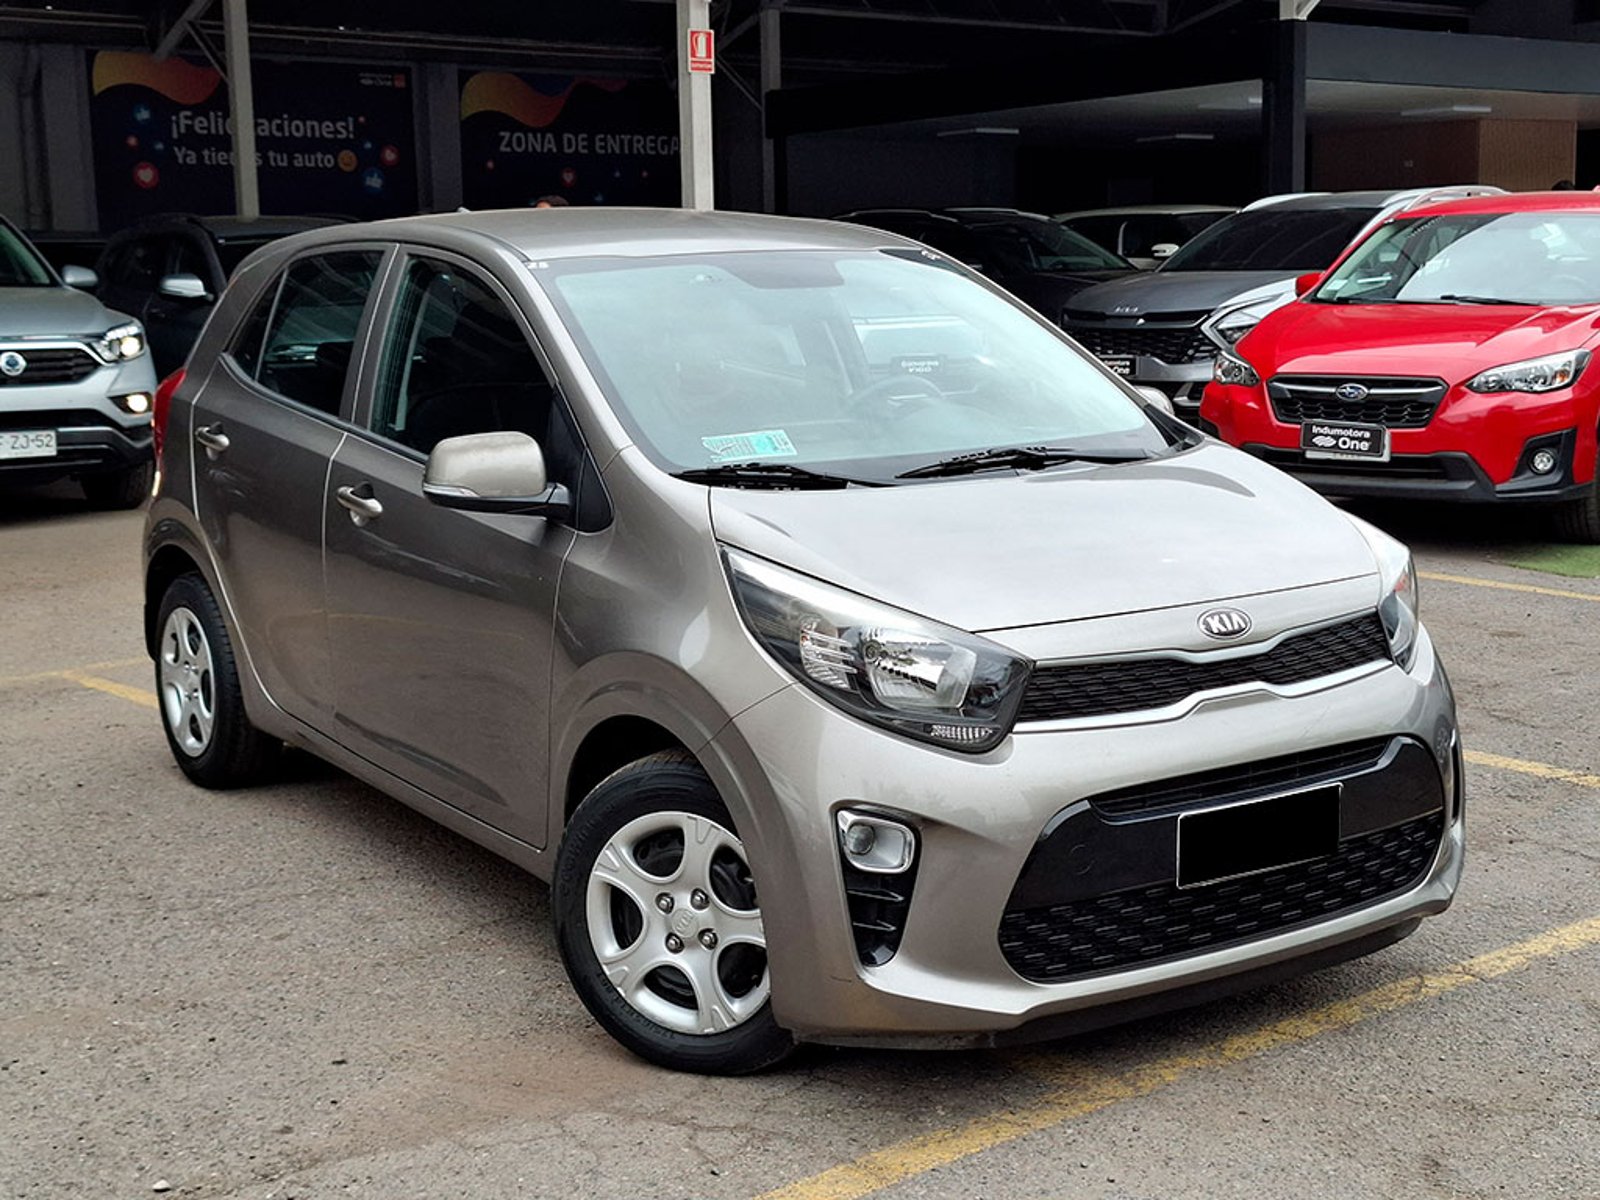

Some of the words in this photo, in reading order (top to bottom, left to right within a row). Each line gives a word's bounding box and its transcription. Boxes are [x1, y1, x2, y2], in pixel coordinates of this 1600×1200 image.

[171, 110, 355, 139] ¡Felicaciones!
[499, 131, 557, 153] ZONA
[562, 133, 589, 154] DE
[595, 134, 681, 155] ENTREGA
[173, 146, 197, 165] Ya
[203, 147, 263, 167] ties
[268, 150, 288, 167] tu
[293, 151, 335, 168] auto
[1312, 425, 1371, 438] Indumotora
[1338, 436, 1370, 450] One
[1206, 612, 1247, 634] KIA
